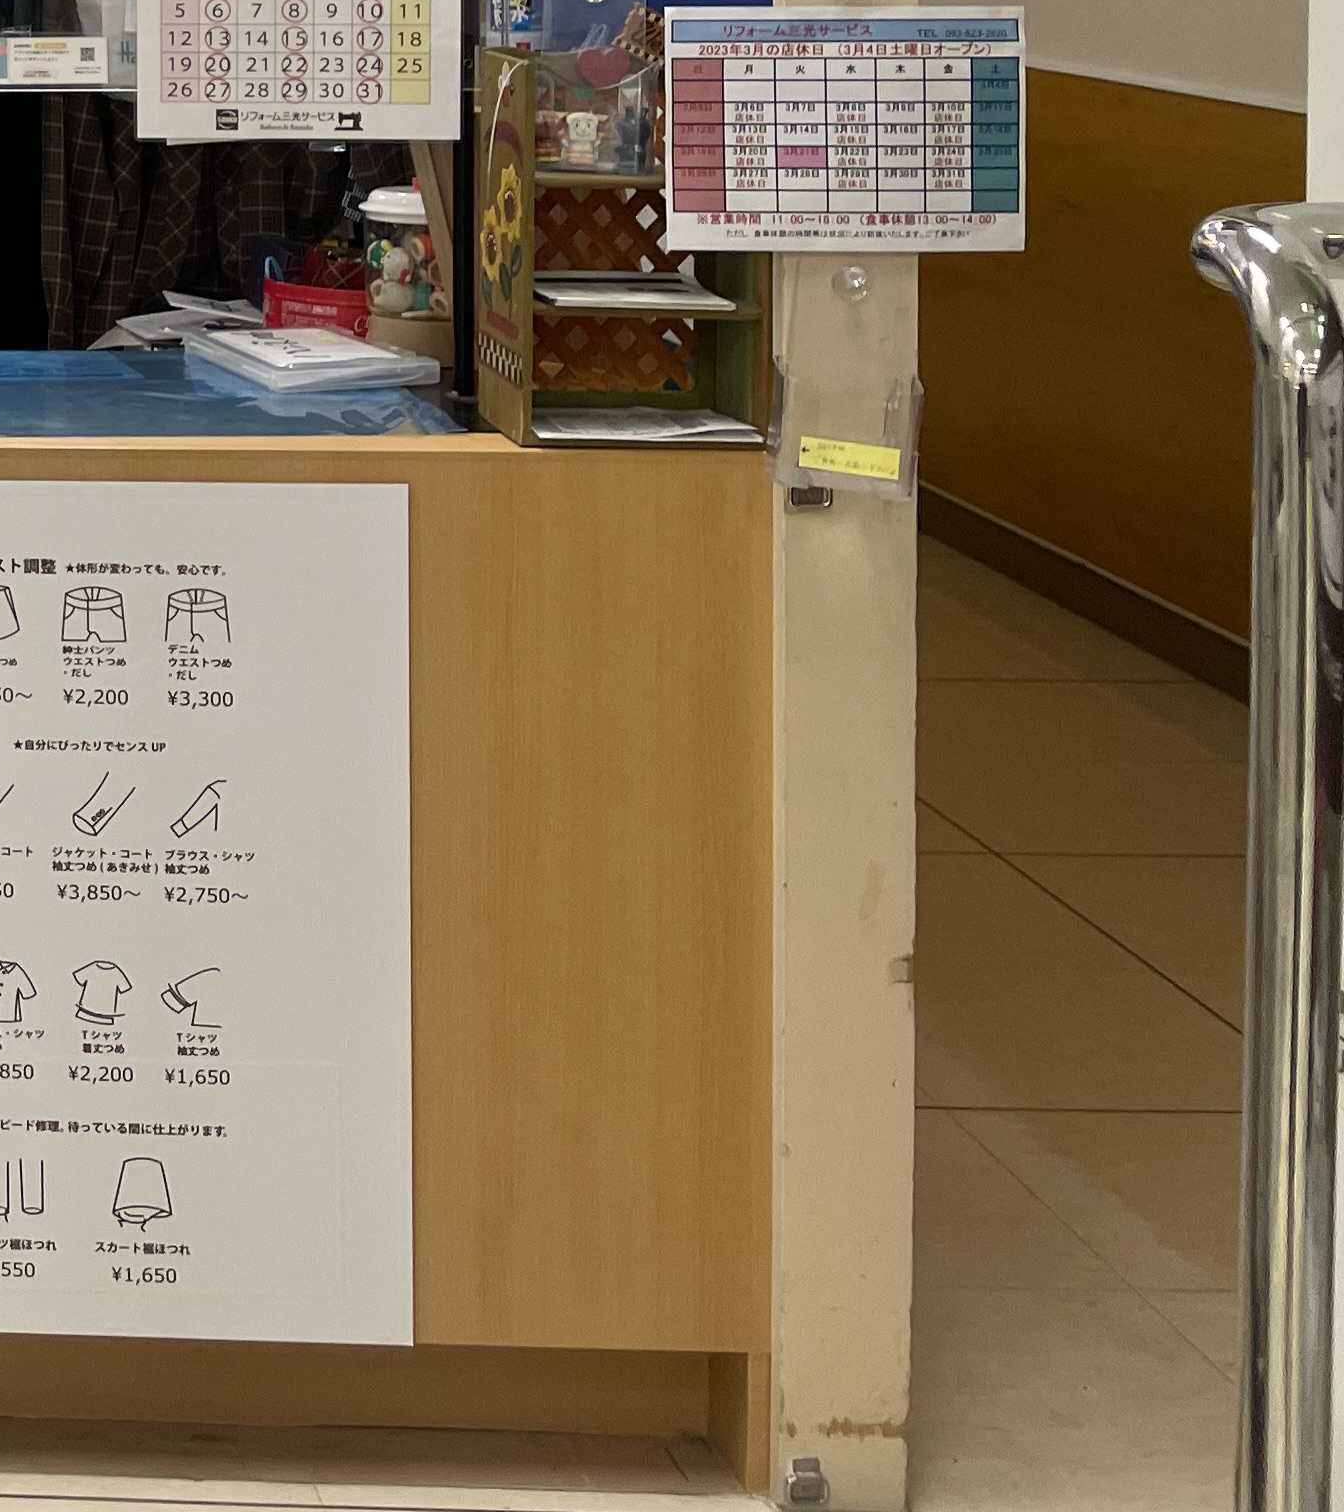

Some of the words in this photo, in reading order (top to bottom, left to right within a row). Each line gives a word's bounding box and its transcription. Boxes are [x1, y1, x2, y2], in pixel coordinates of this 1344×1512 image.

[175, 4, 184, 17] 5
[213, 4, 223, 18] 6
[252, 4, 262, 17] 7
[289, 4, 299, 18] 8
[327, 4, 337, 18] 9
[359, 4, 382, 18] 10
[400, 4, 421, 17] 11
[723, 24, 873, 37] リフォーム三光サービス
[168, 32, 191, 46] 12
[207, 32, 230, 46] 13
[245, 32, 268, 46] 14
[284, 32, 306, 46] 15
[320, 32, 343, 46] 16
[359, 32, 382, 46] 17
[398, 32, 421, 46] 18
[699, 43, 824, 56] 2023年3月の店休日
[169, 58, 192, 72] 19
[206, 58, 231, 72] 20
[246, 58, 268, 72] 21
[282, 58, 306, 72] 22
[319, 58, 343, 72] 23
[357, 59, 382, 72] 24
[397, 59, 422, 73] 25
[744, 64, 753, 75] 月
[795, 65, 806, 75] 火
[845, 64, 856, 75] 水
[944, 64, 954, 74] 金
[168, 83, 192, 97] 26
[206, 83, 230, 97] 27
[245, 83, 269, 97] 28
[282, 83, 306, 97] 29
[319, 84, 343, 97] 30
[361, 84, 381, 98] 31
[168, 644, 199, 655] デニム
[63, 657, 126, 666] ウエストつめ
[168, 658, 232, 668] ウエストつめ
[63, 689, 129, 707] ¥2,200
[168, 691, 233, 709] ¥3,300
[152, 742, 166, 753] UP
[52, 848, 152, 859] ジャケット・コート
[165, 864, 210, 875] 袖丈つめ
[82, 1030, 122, 1040] Tシャツ
[177, 1033, 217, 1043] Tシャツ
[177, 1046, 220, 1056] 袖丈つめ
[69, 1065, 134, 1084] ¥2,200
[165, 1068, 230, 1087] ¥1,650
[112, 1267, 176, 1285] ¥1,650
